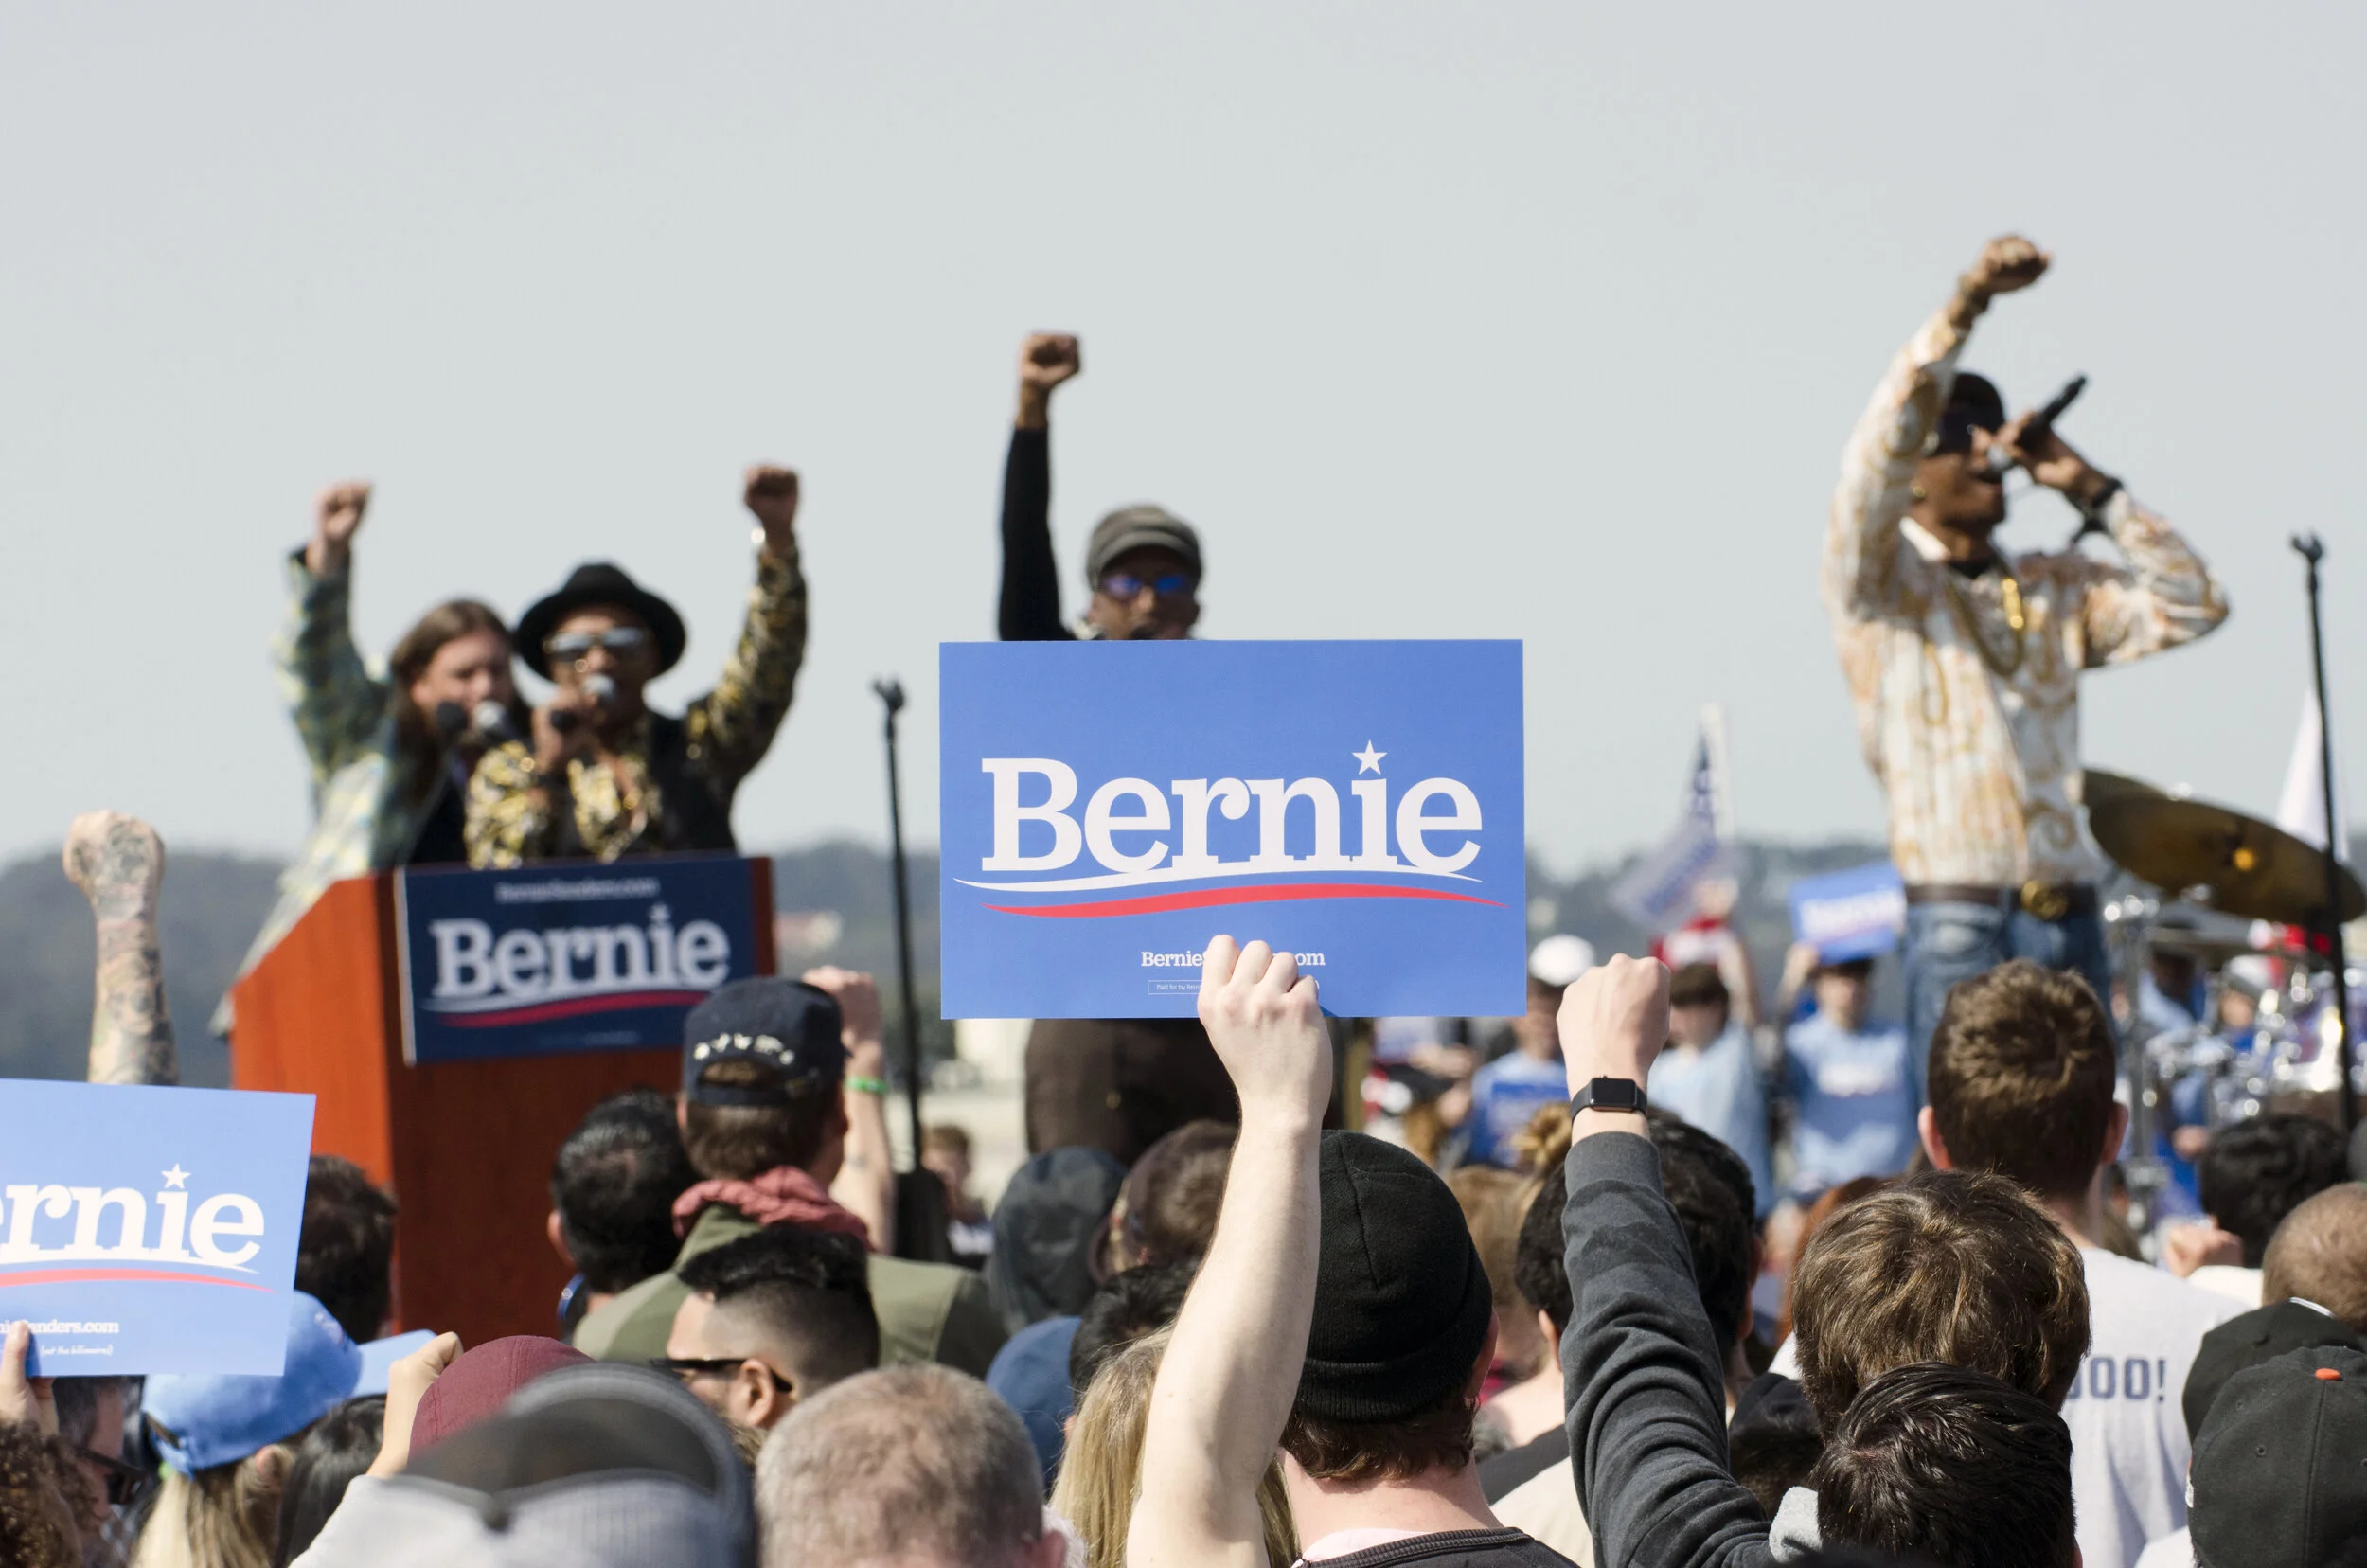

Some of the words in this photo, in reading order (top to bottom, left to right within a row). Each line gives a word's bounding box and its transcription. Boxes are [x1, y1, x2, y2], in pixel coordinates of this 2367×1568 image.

[981, 739, 1483, 873] Bernie
[429, 903, 730, 997] Bernie
[0, 1163, 265, 1265] rnie
